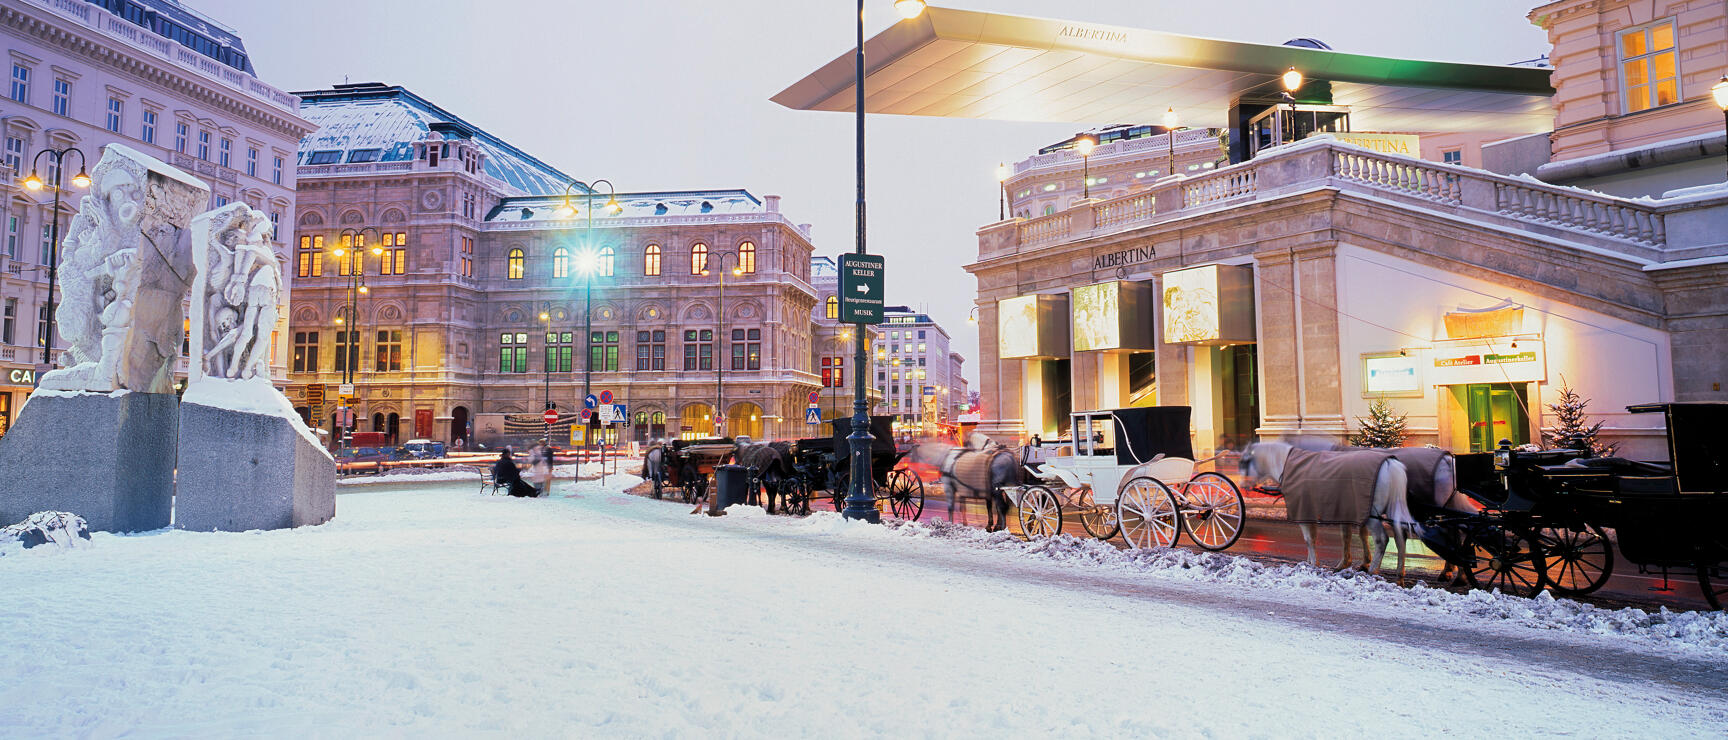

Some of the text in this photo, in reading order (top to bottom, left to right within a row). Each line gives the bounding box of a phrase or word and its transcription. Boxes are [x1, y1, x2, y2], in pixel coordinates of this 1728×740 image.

[1059, 25, 1127, 42] ALBERTINA
[1094, 244, 1156, 269] ALBERTINA
[845, 260, 883, 270] AUGUSTINER
[852, 269, 875, 277] KELLER
[854, 308, 873, 316] MUSIK
